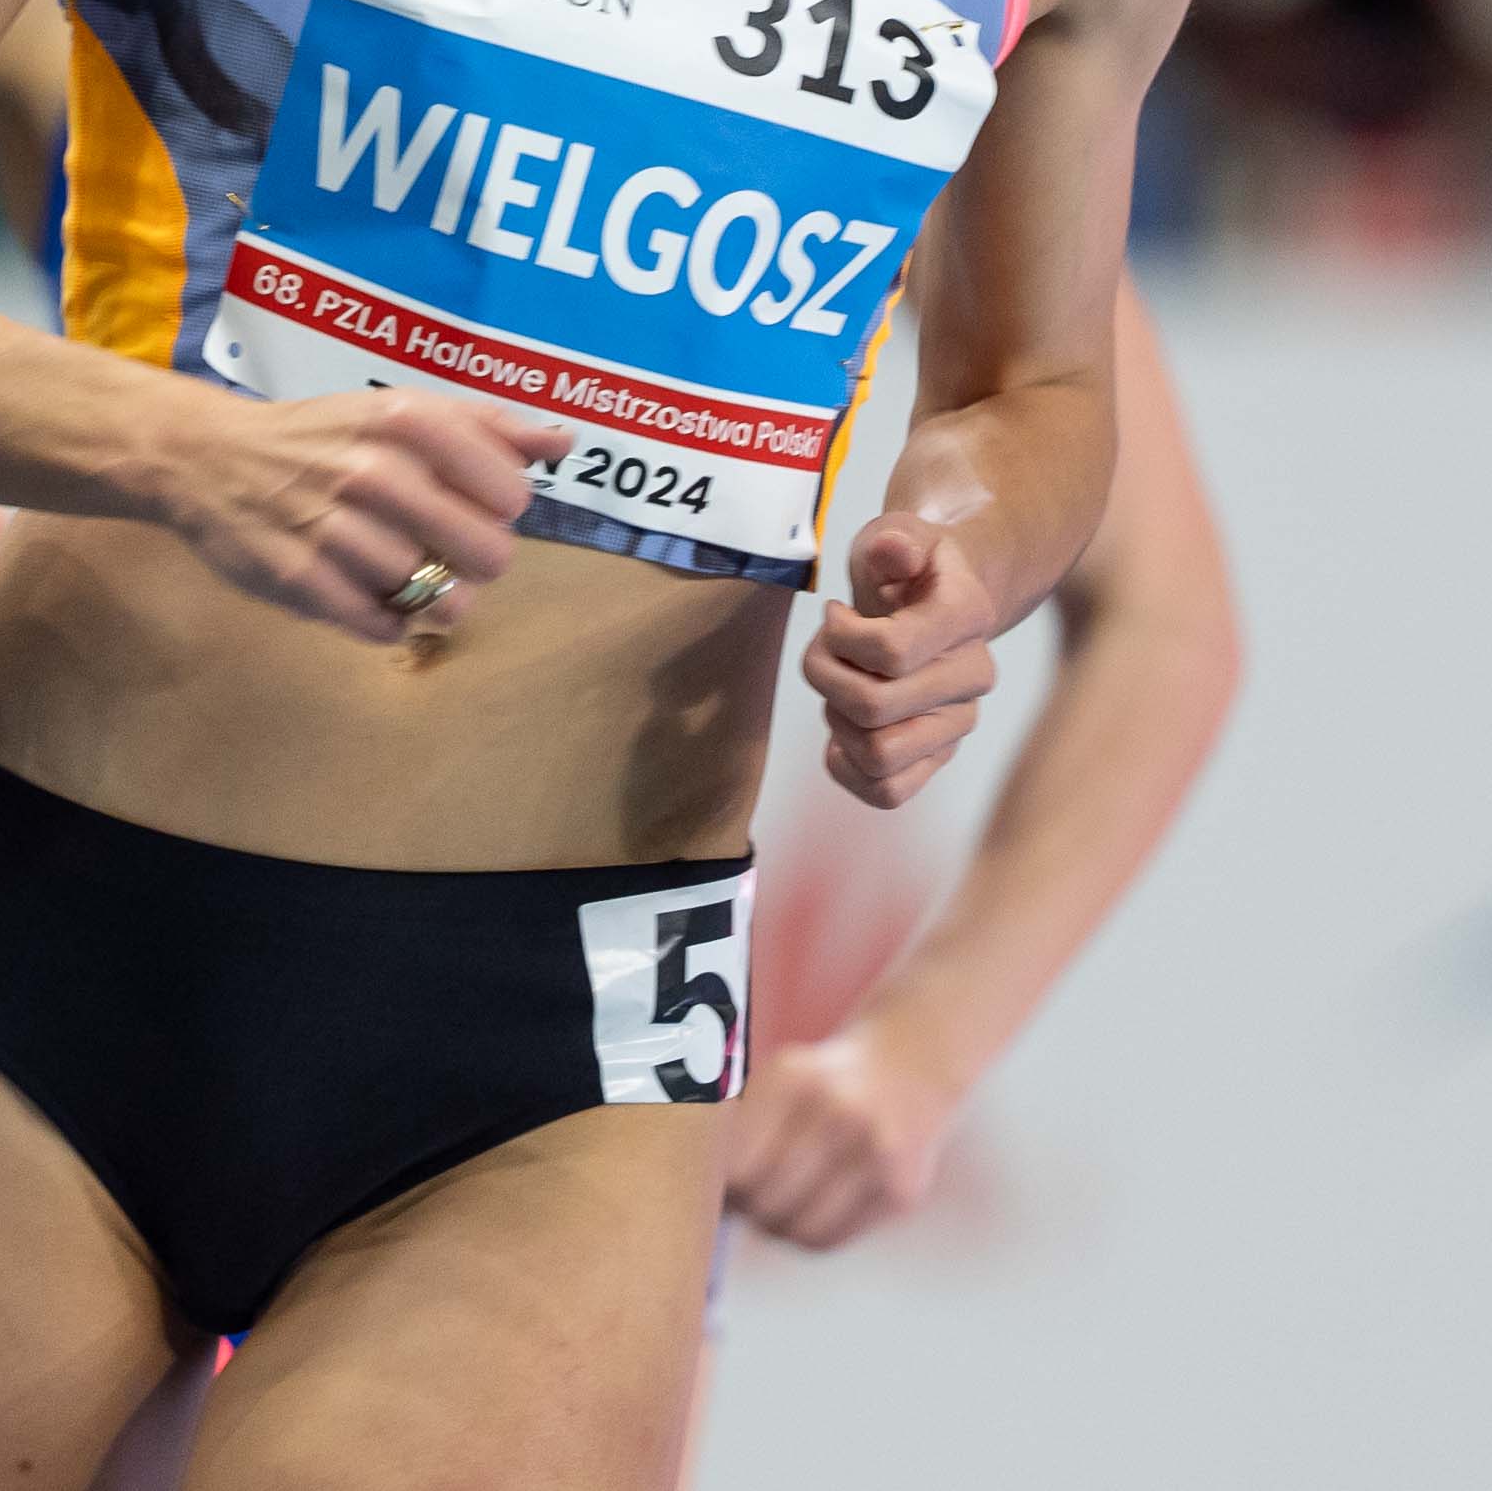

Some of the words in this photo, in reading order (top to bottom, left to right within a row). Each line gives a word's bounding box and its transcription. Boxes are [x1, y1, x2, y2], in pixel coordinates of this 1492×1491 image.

[314, 62, 900, 338] WIELGOSZ
[252, 263, 307, 311] 68.
[312, 289, 398, 346] PZLA
[404, 325, 547, 394] Halowe
[549, 370, 752, 447] Mistrzostwa
[753, 420, 824, 461] Polski
[573, 446, 714, 515] 2024
[649, 898, 738, 1103] 5
